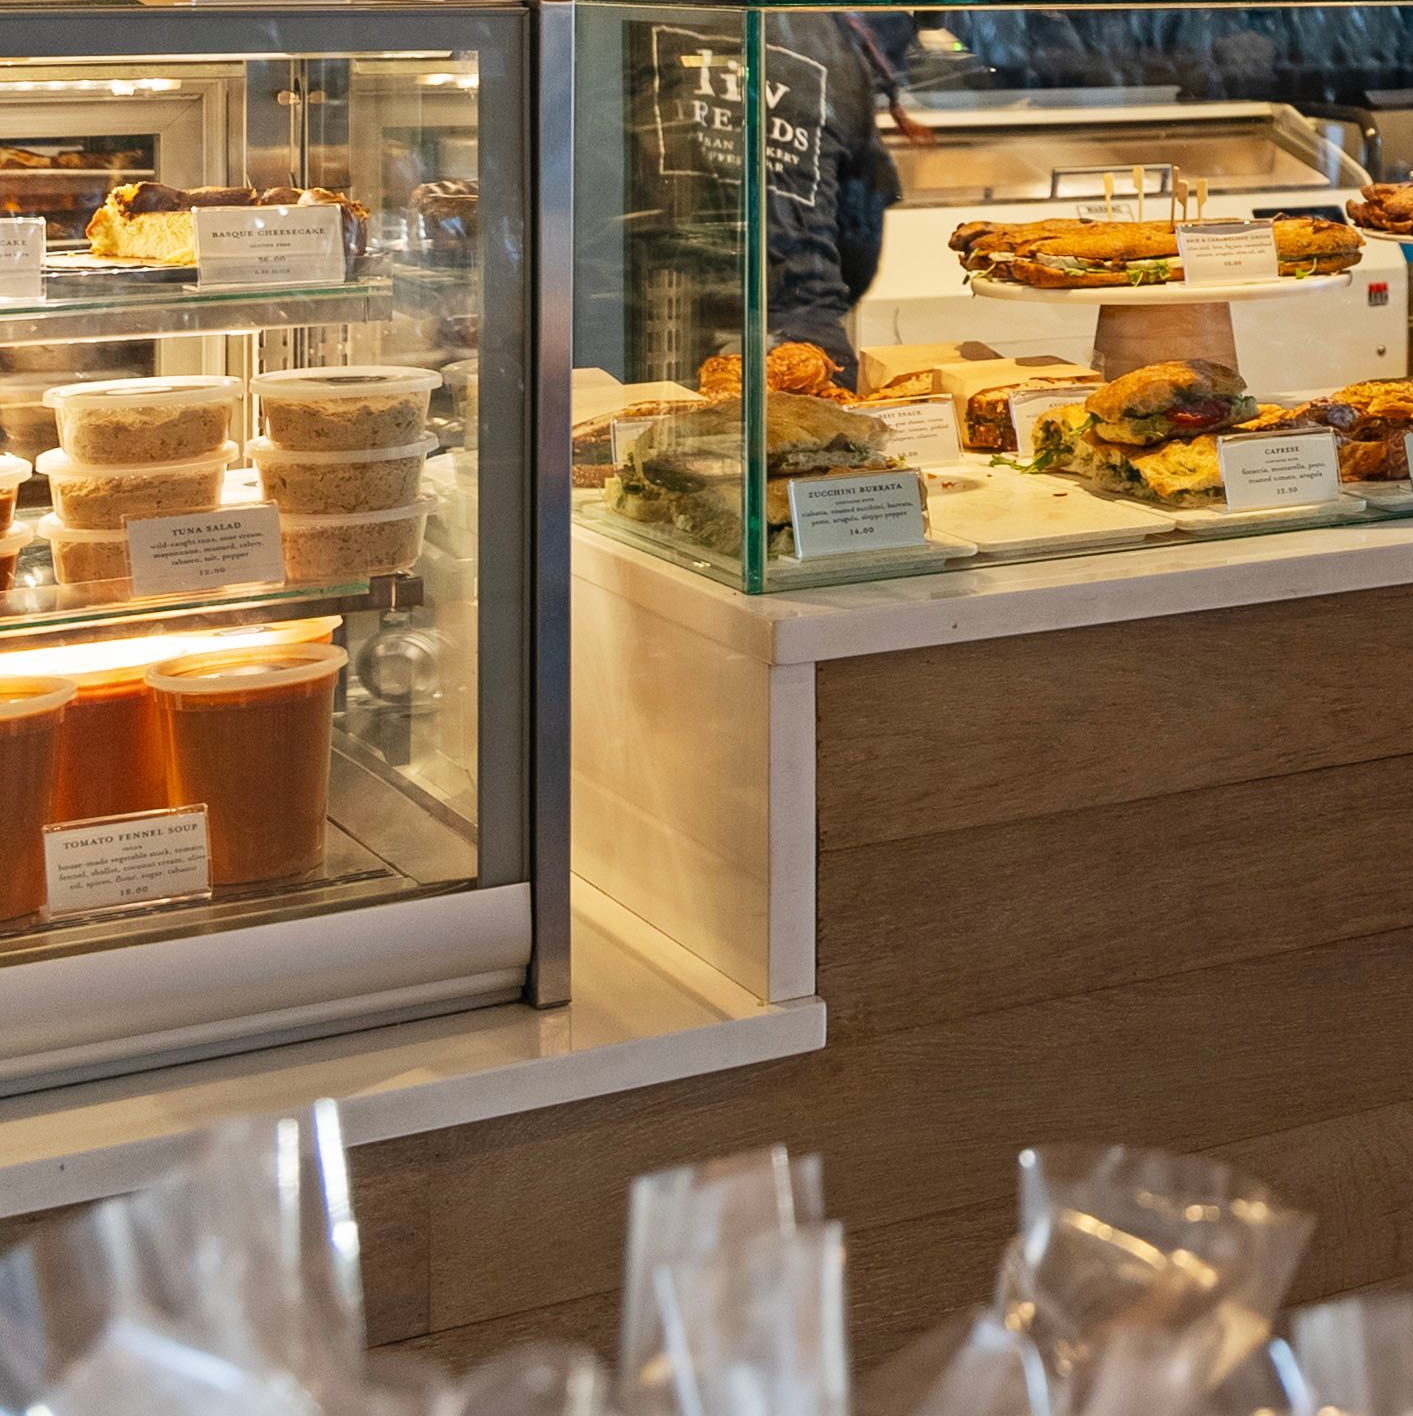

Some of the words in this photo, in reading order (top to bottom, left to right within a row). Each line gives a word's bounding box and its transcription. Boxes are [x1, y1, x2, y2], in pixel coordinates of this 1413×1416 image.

[212, 230, 253, 239] BASQUE
[257, 227, 326, 237] CHEESECAKE
[1264, 446, 1300, 455] CAPRESE
[808, 488, 856, 499] ZUCCHINI
[859, 484, 902, 493] BURRATA
[172, 527, 202, 537] TUNA
[206, 522, 241, 532] SALAD
[63, 836, 114, 850] TOMATO
[119, 829, 164, 841] FENNEL
[168, 823, 199, 834] SOUP
